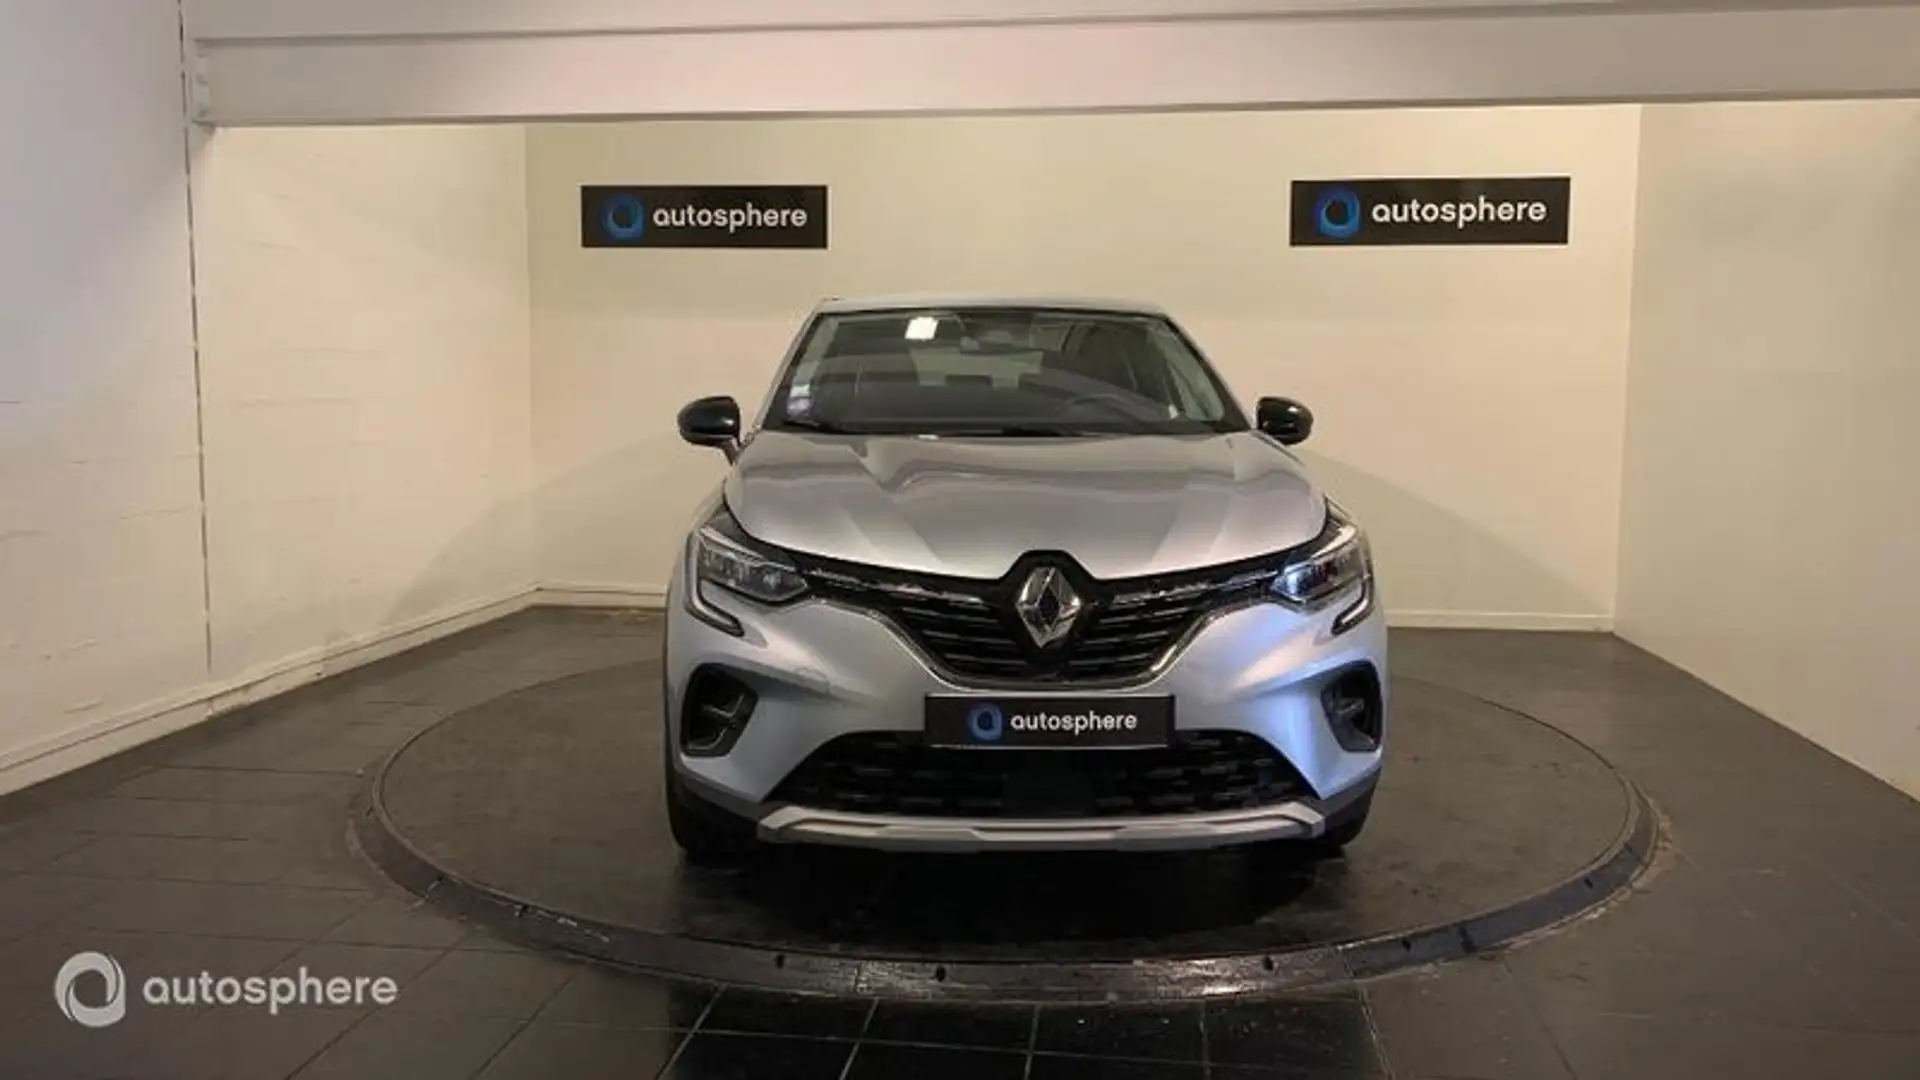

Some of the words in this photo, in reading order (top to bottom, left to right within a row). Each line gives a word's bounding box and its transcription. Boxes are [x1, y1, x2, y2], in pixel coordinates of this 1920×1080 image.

[653, 202, 807, 233] autosphere
[1372, 195, 1546, 229] autosphere
[1010, 710, 1137, 735] autosphere
